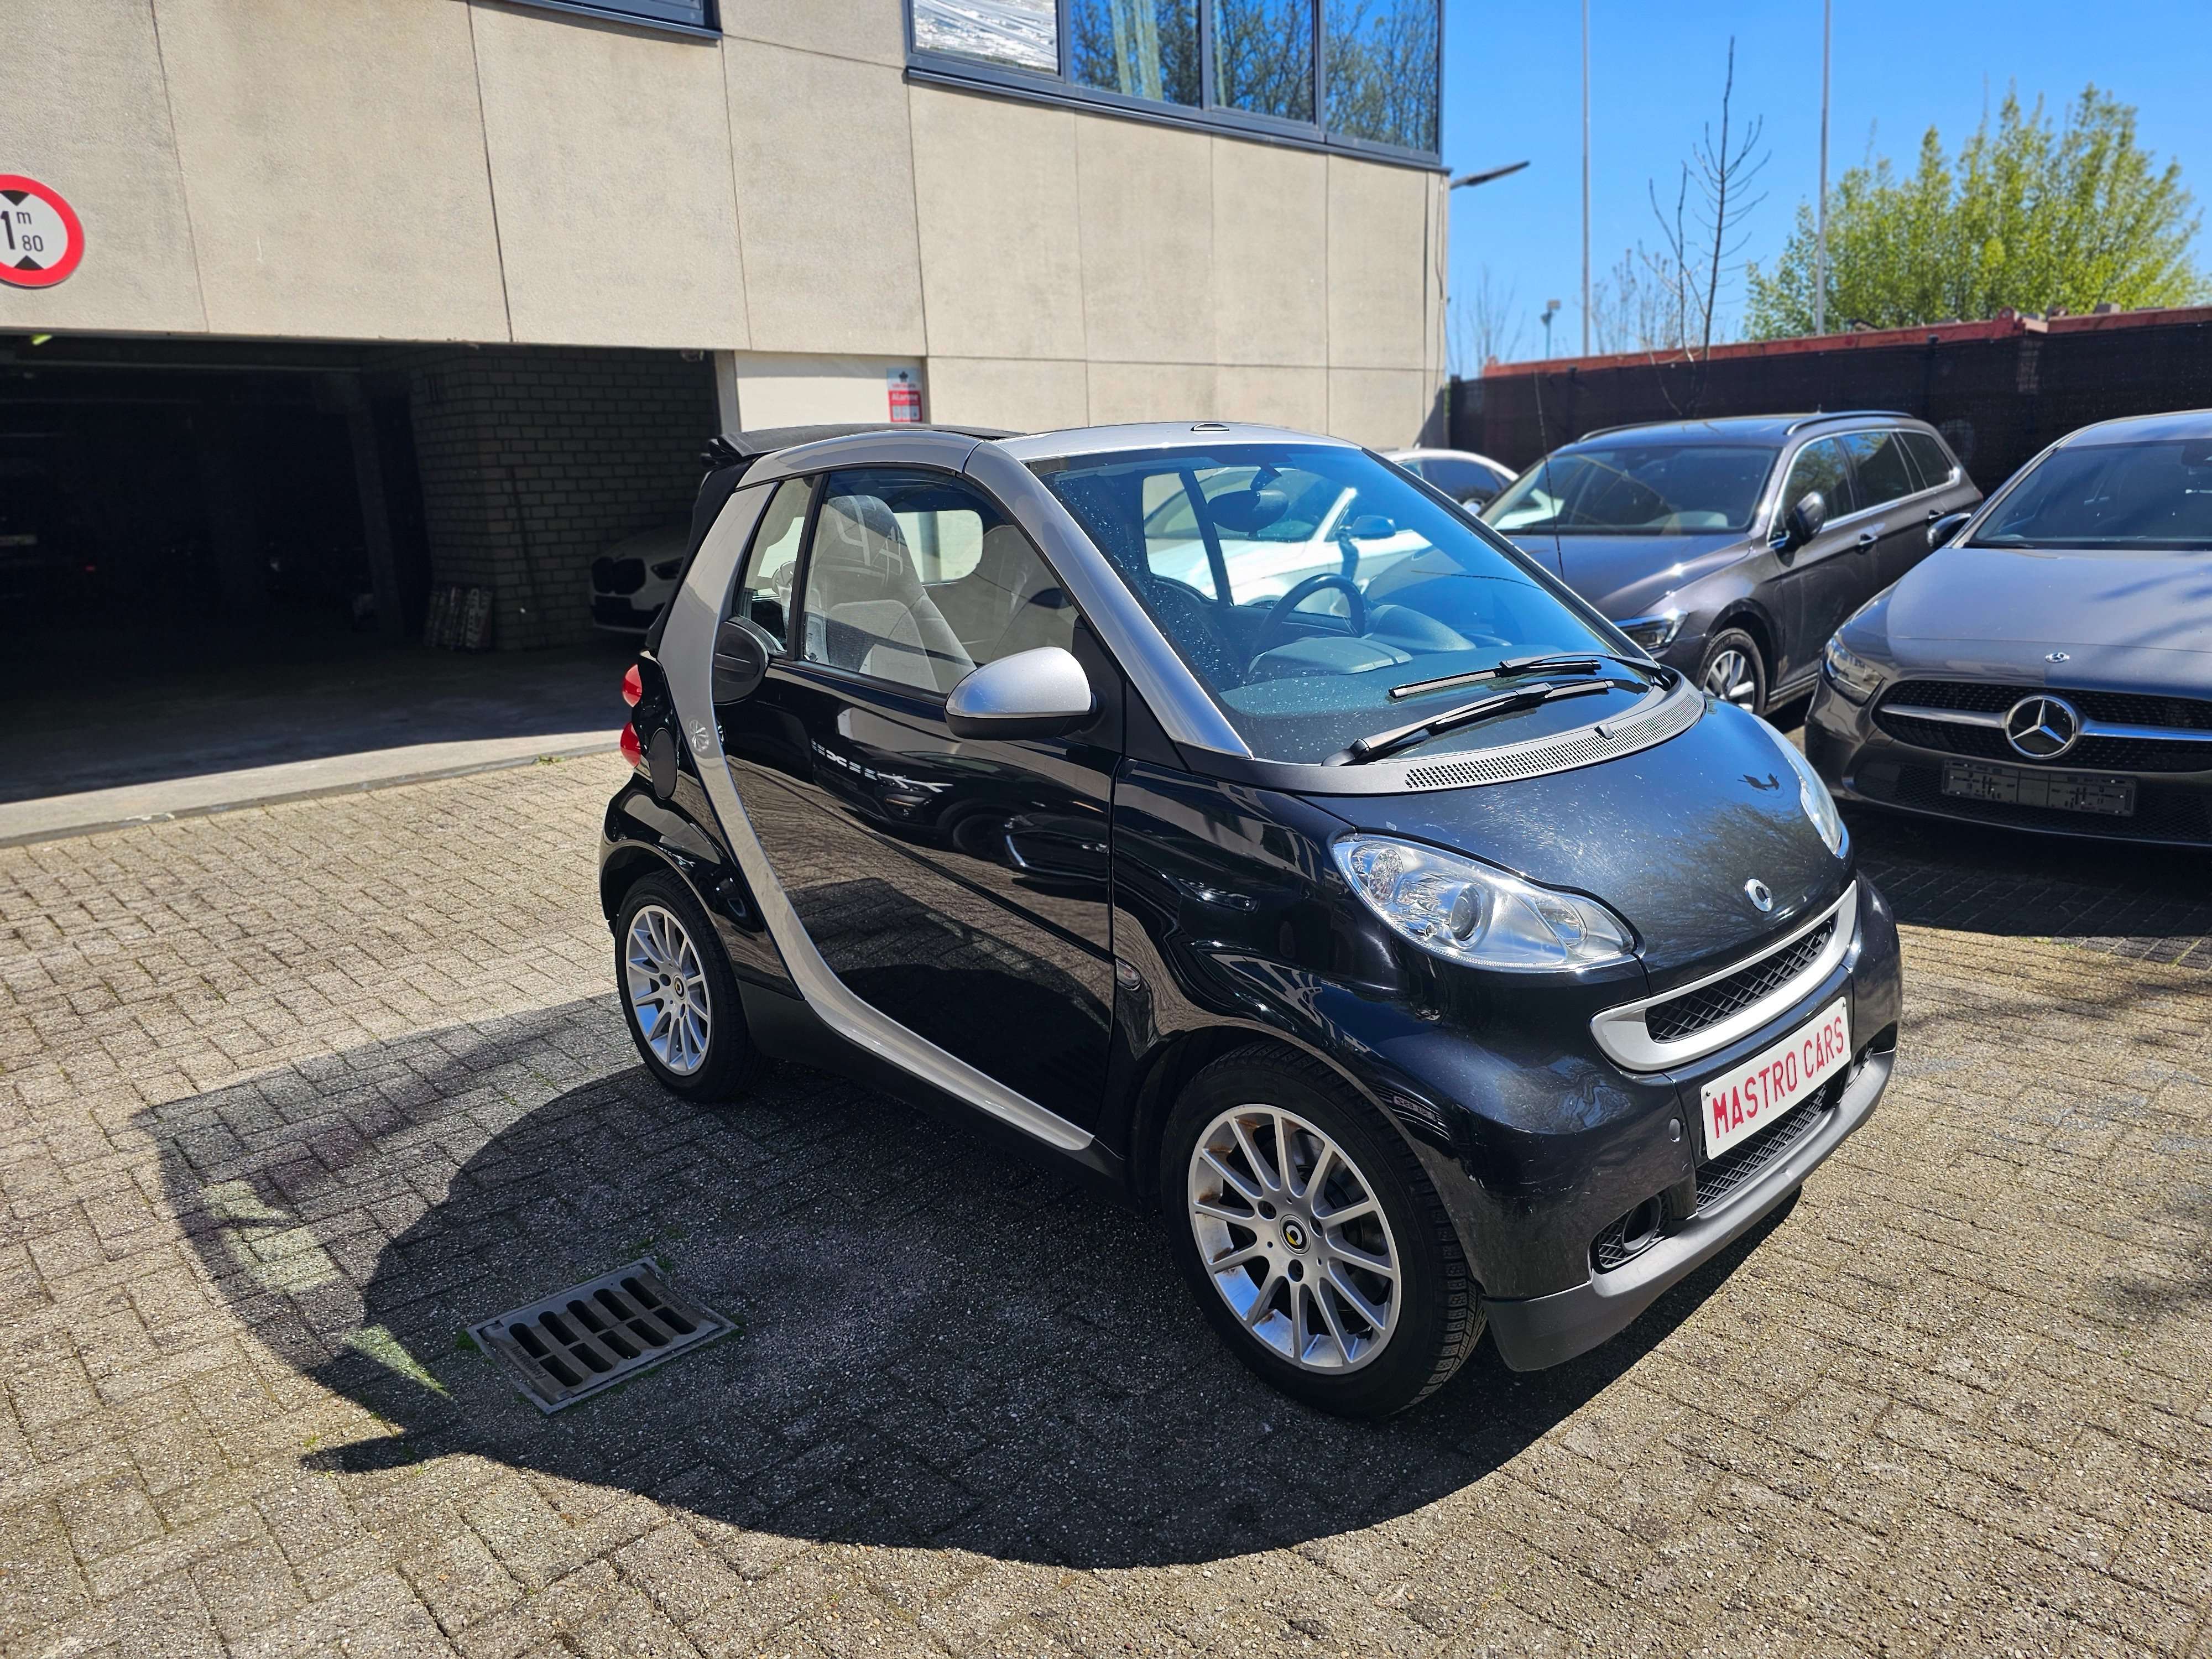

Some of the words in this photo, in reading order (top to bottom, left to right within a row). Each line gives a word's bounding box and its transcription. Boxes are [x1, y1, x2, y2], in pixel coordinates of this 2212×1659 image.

[1, 211, 15, 250] 1
[22, 235, 44, 252] 80
[1712, 1051, 1797, 1139] MASTRO
[1803, 1016, 1844, 1078] CARS
